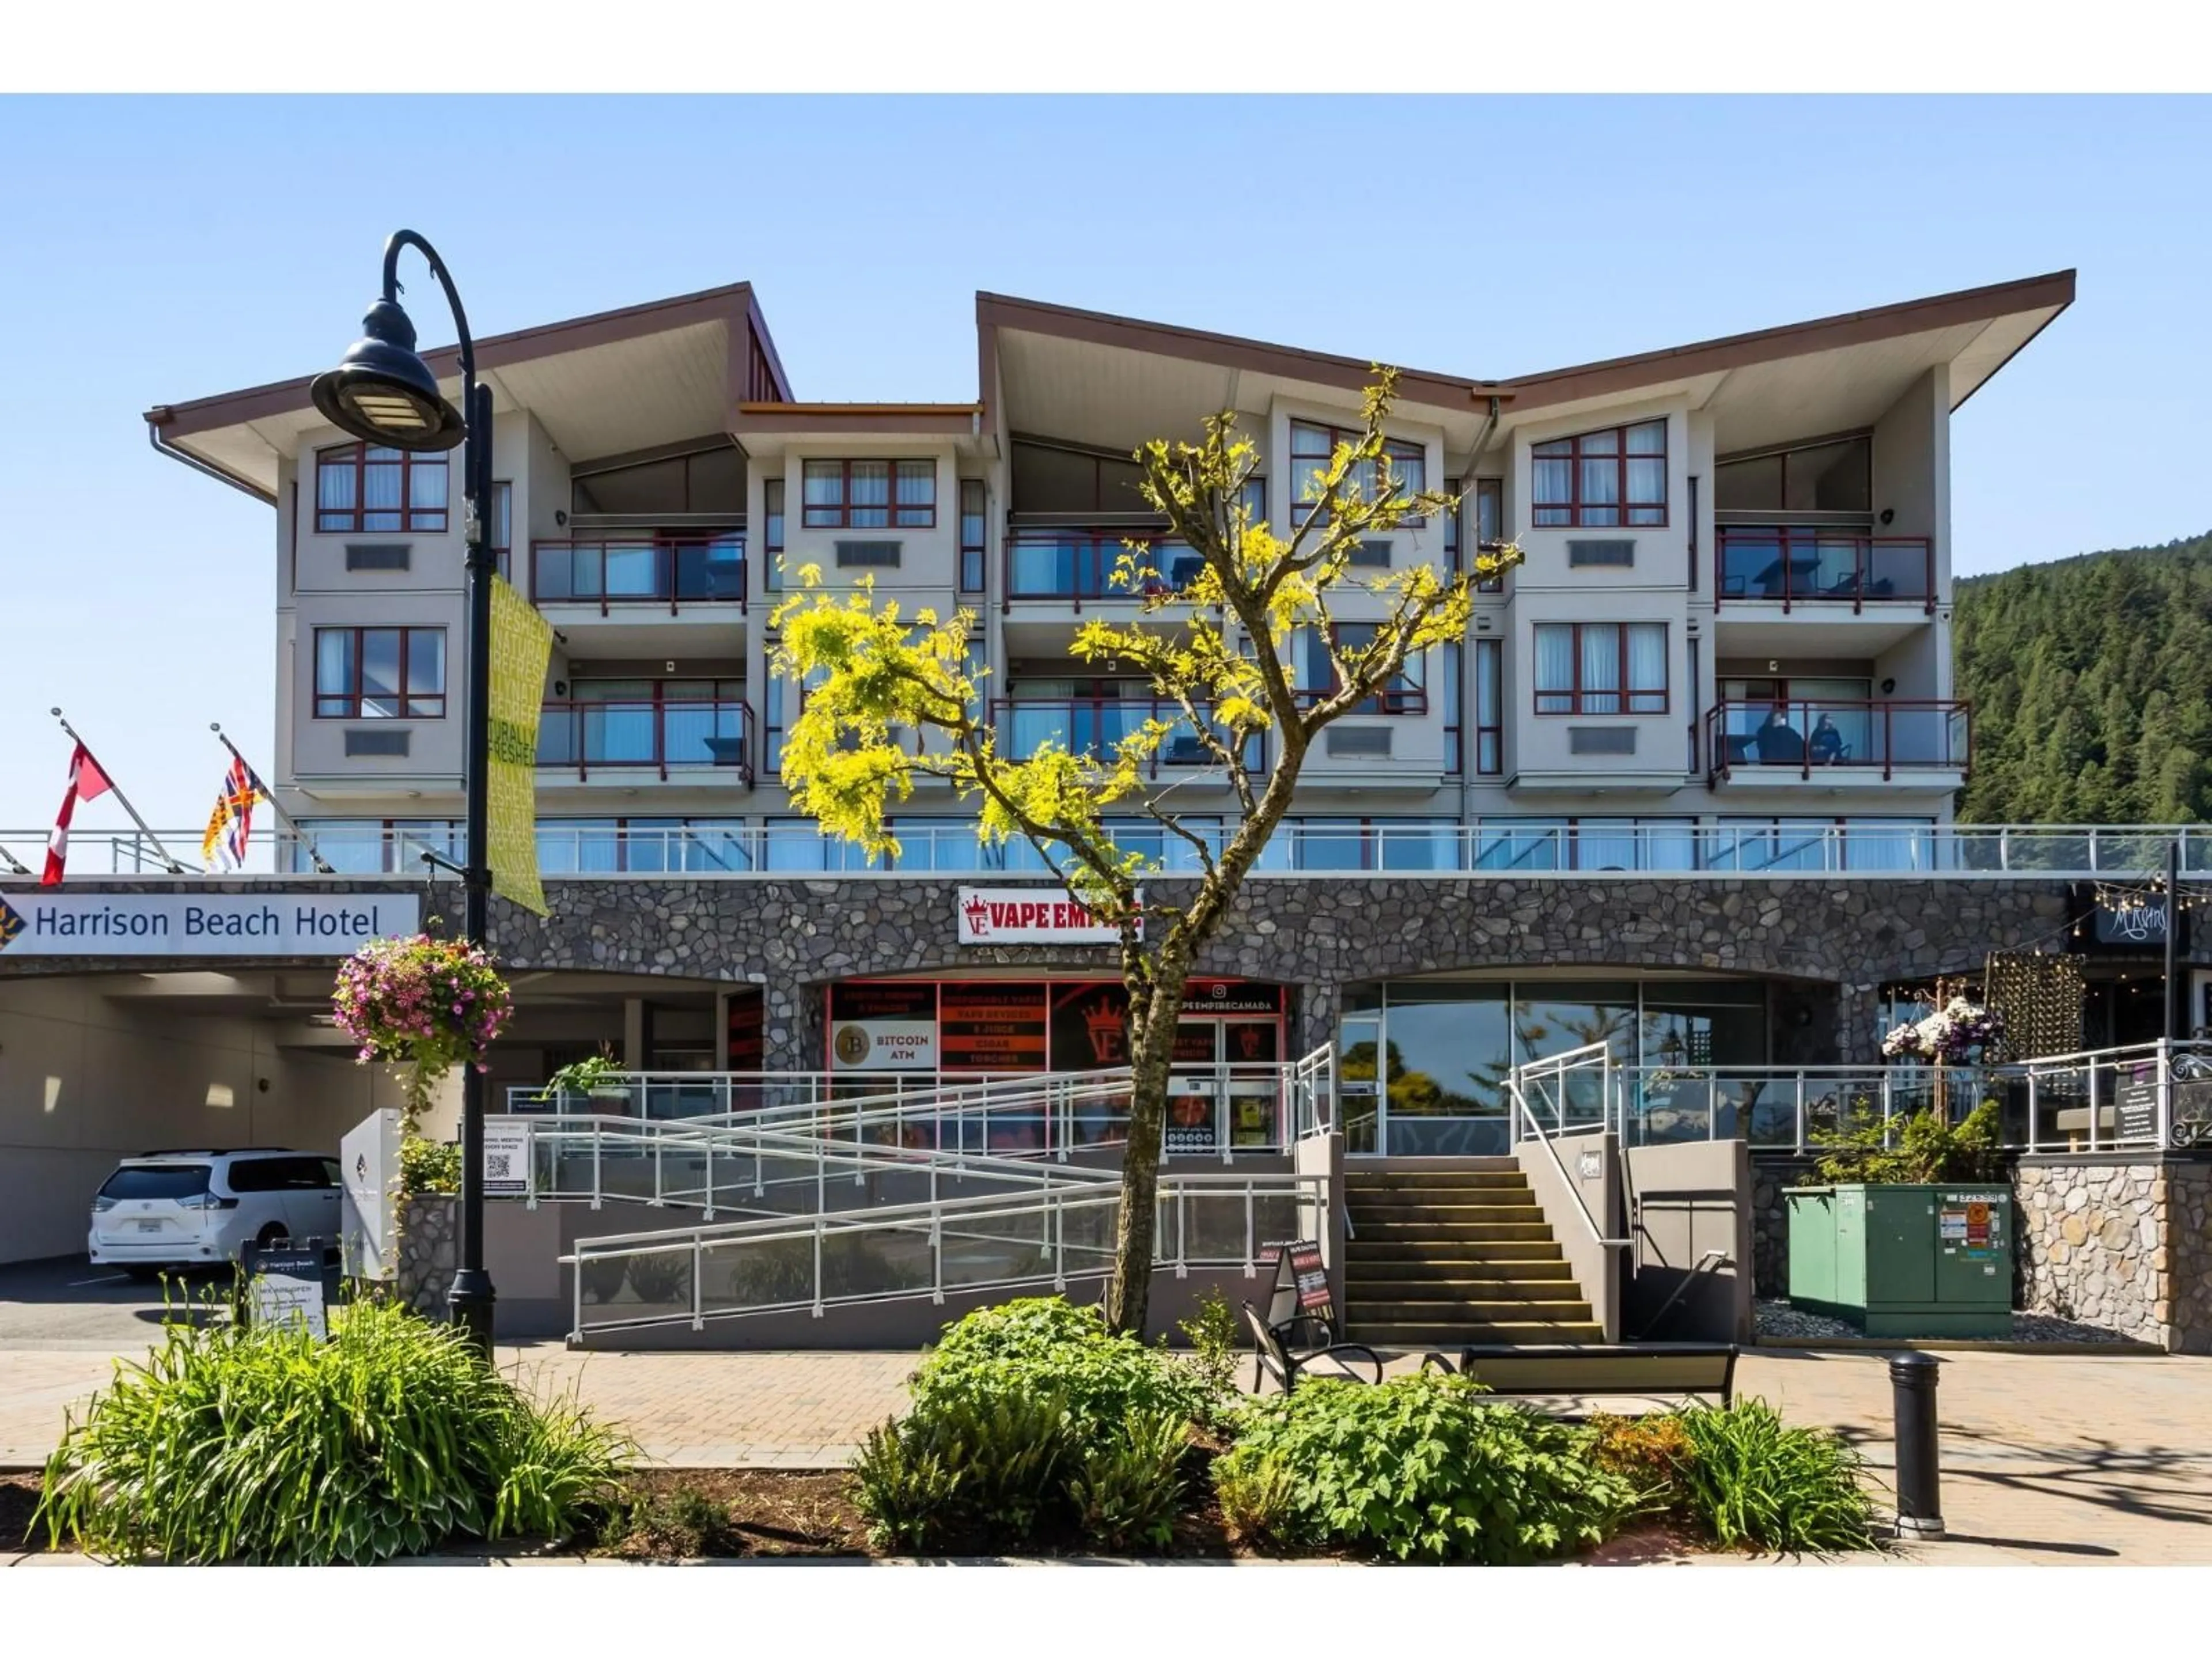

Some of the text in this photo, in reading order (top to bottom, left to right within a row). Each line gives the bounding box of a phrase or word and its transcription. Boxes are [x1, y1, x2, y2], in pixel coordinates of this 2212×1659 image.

[36, 906, 378, 937] Harrison Beach Hotel
[989, 903, 1048, 929] VAPE
[877, 1036, 929, 1046] BITCOIN
[891, 1050, 915, 1060] ATM
